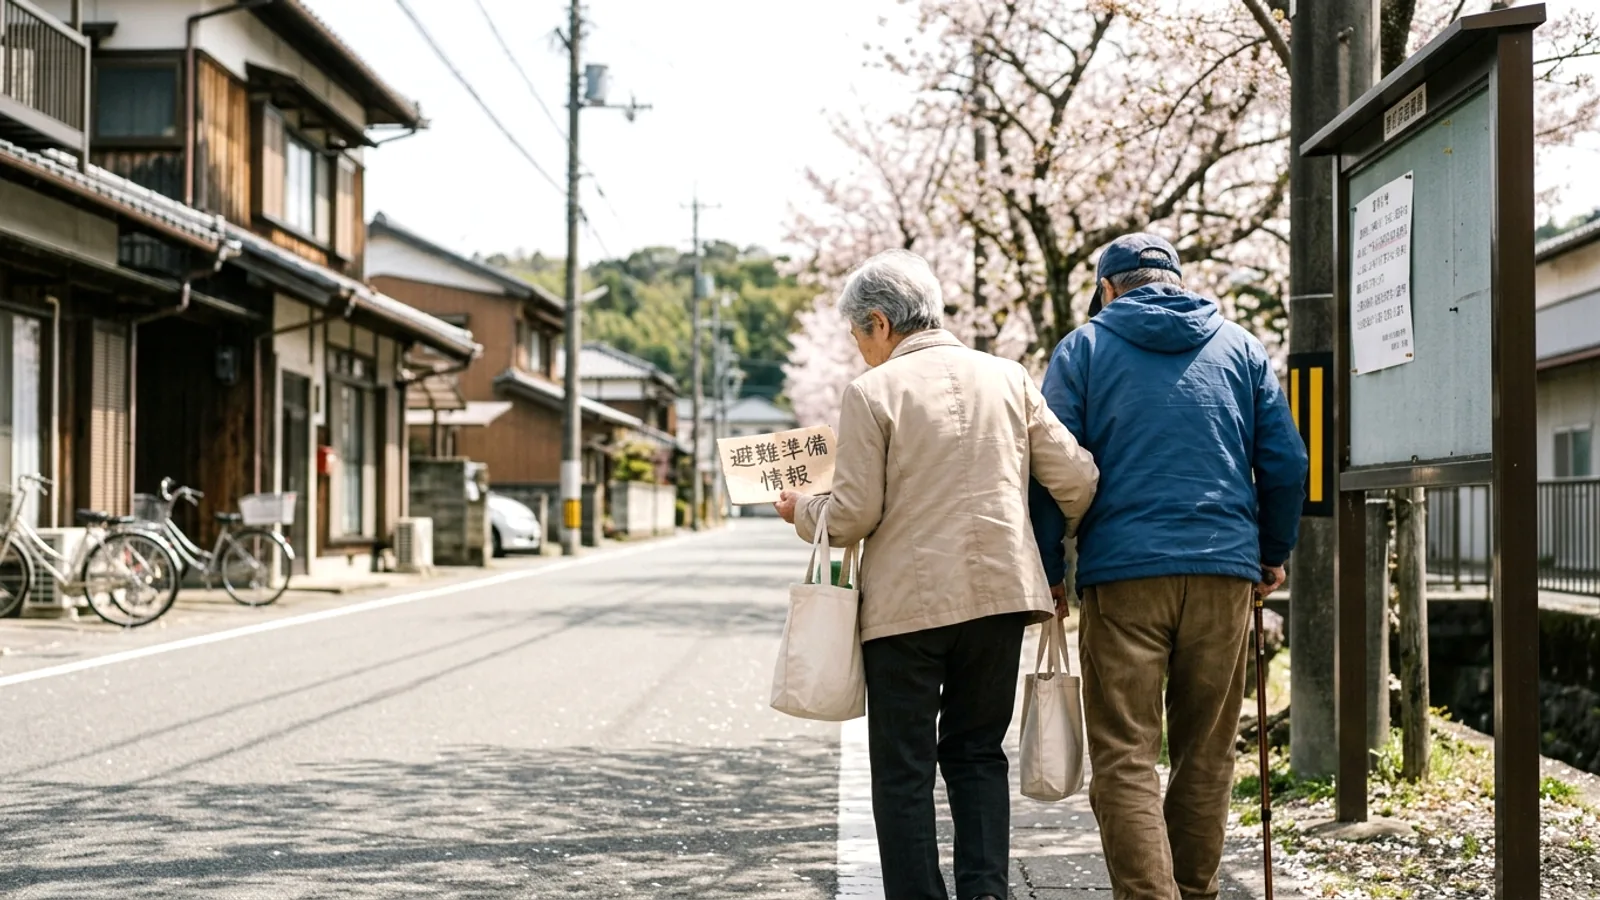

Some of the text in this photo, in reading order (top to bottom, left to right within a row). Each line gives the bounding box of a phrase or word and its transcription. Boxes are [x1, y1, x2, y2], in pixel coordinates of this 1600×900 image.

[729, 433, 828, 468] 避難準備
[760, 464, 812, 491] 情報
